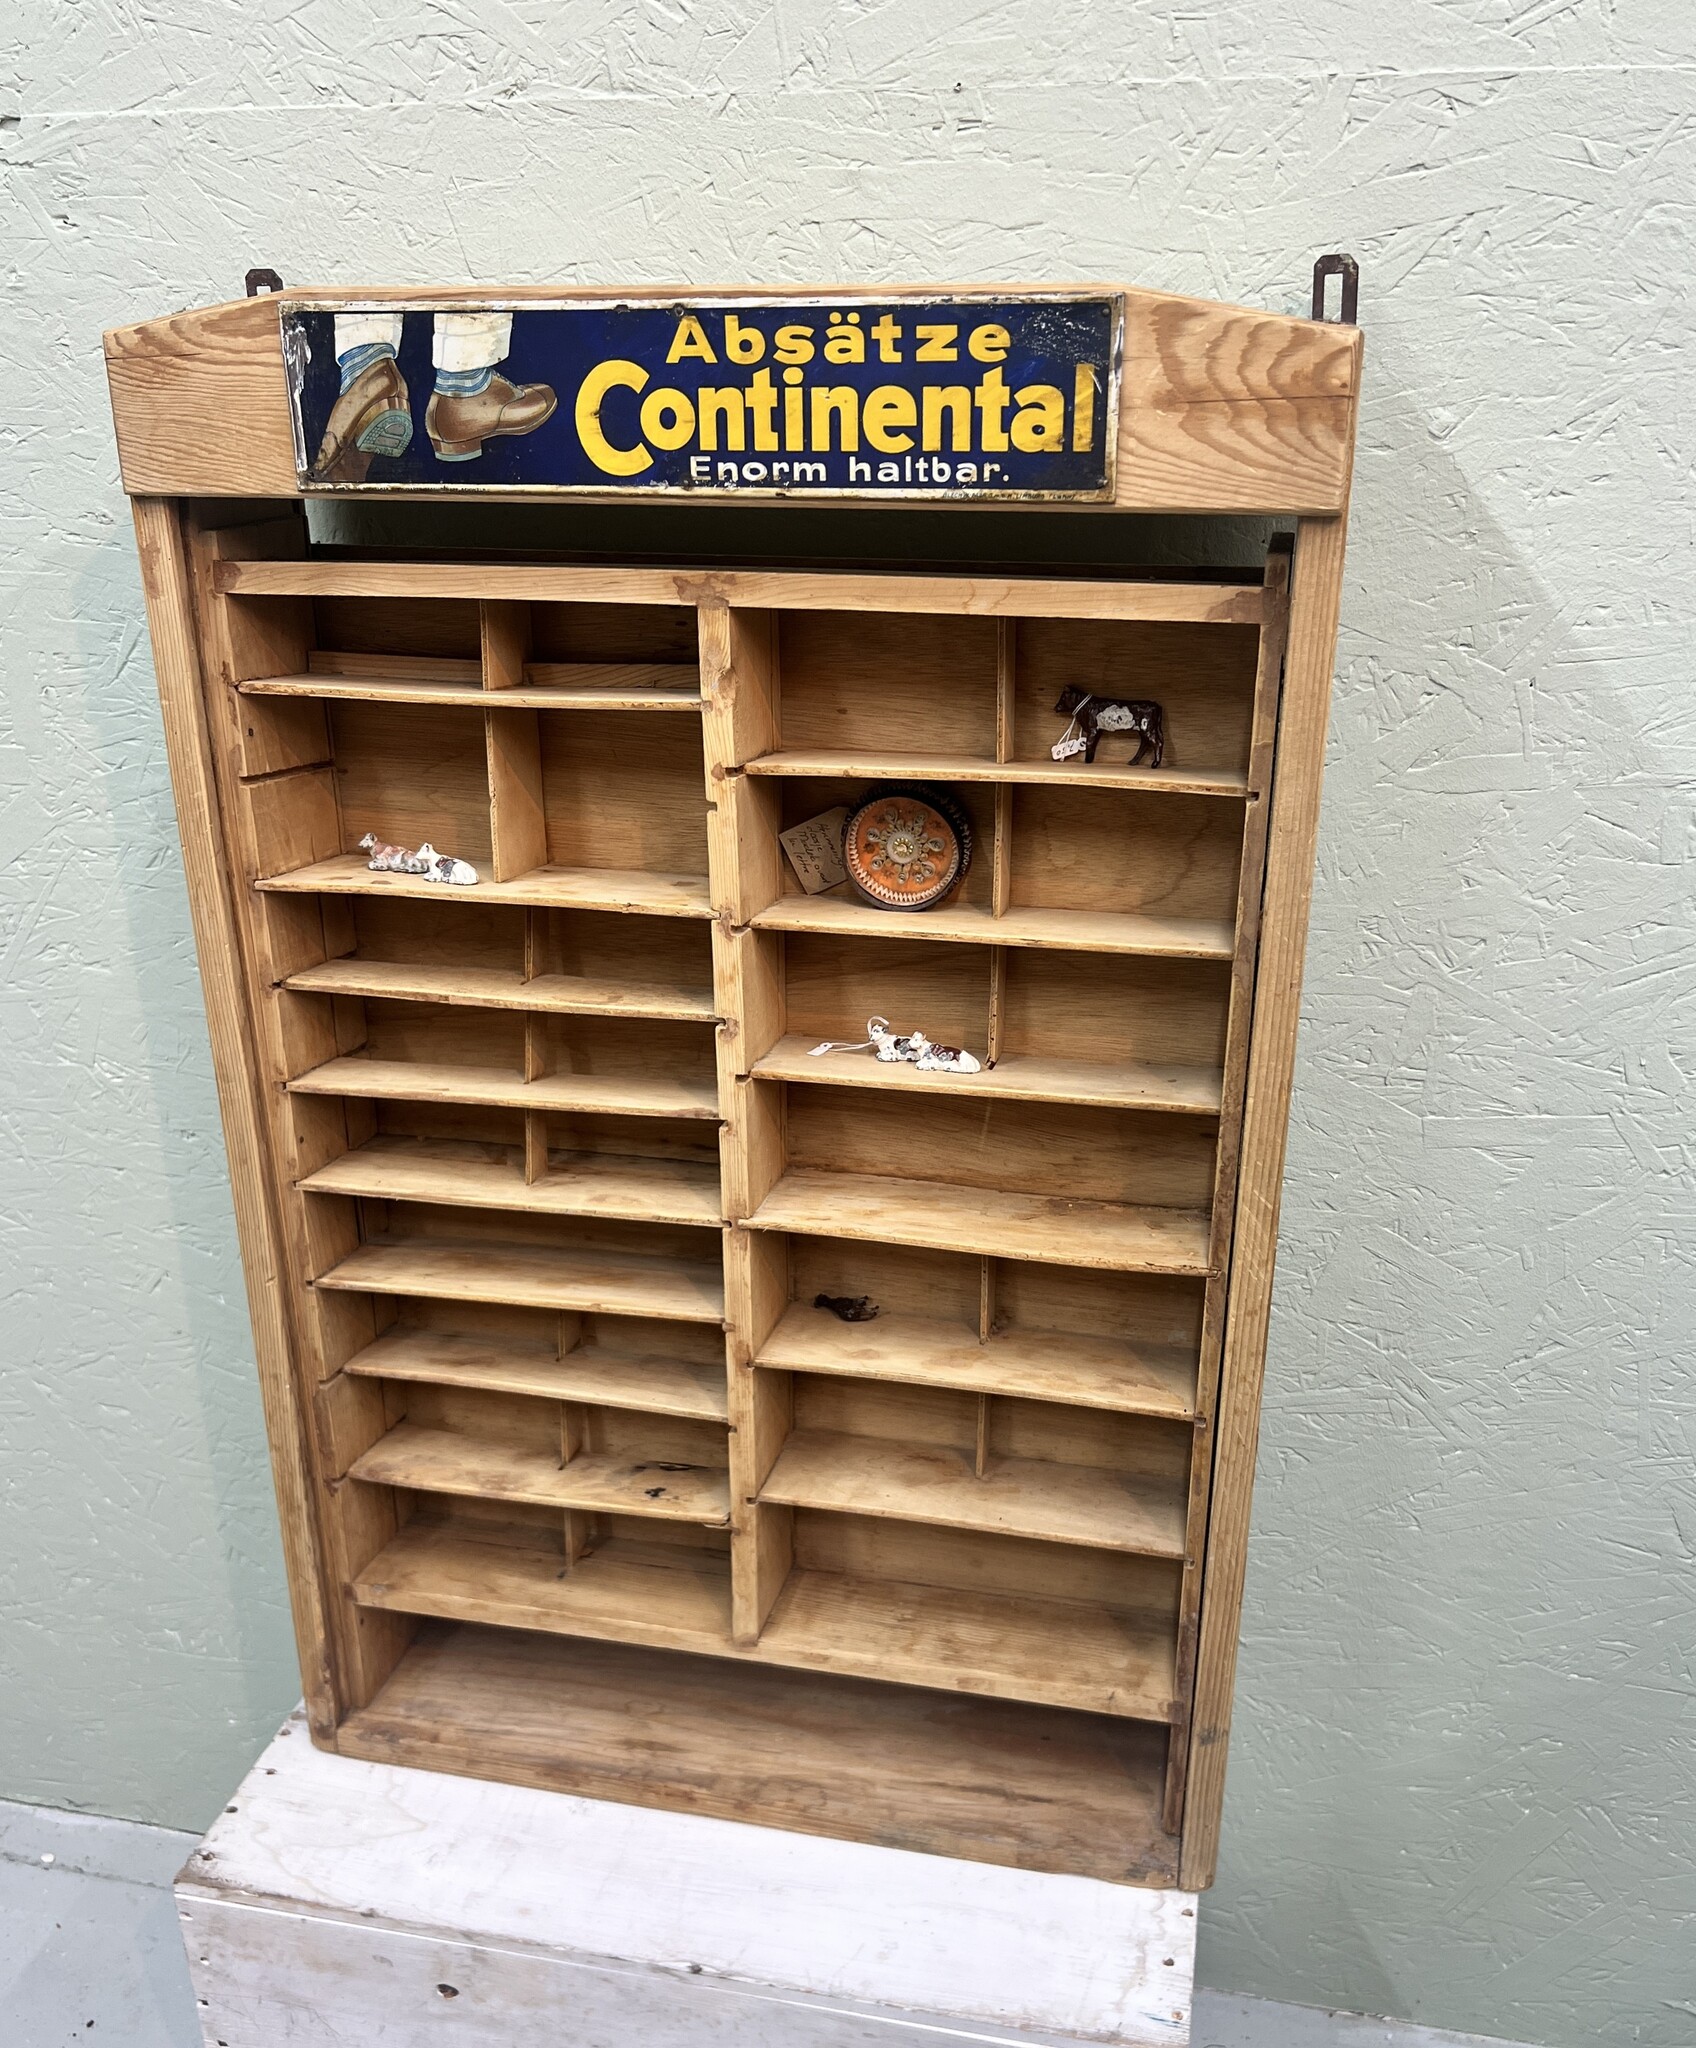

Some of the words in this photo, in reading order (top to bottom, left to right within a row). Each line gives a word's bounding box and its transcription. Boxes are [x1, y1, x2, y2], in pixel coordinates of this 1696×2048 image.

[665, 312, 1011, 365] Absätze
[575, 359, 1095, 477] Continental
[690, 456, 827, 482] Enorm
[848, 456, 1010, 483] haltbar.
